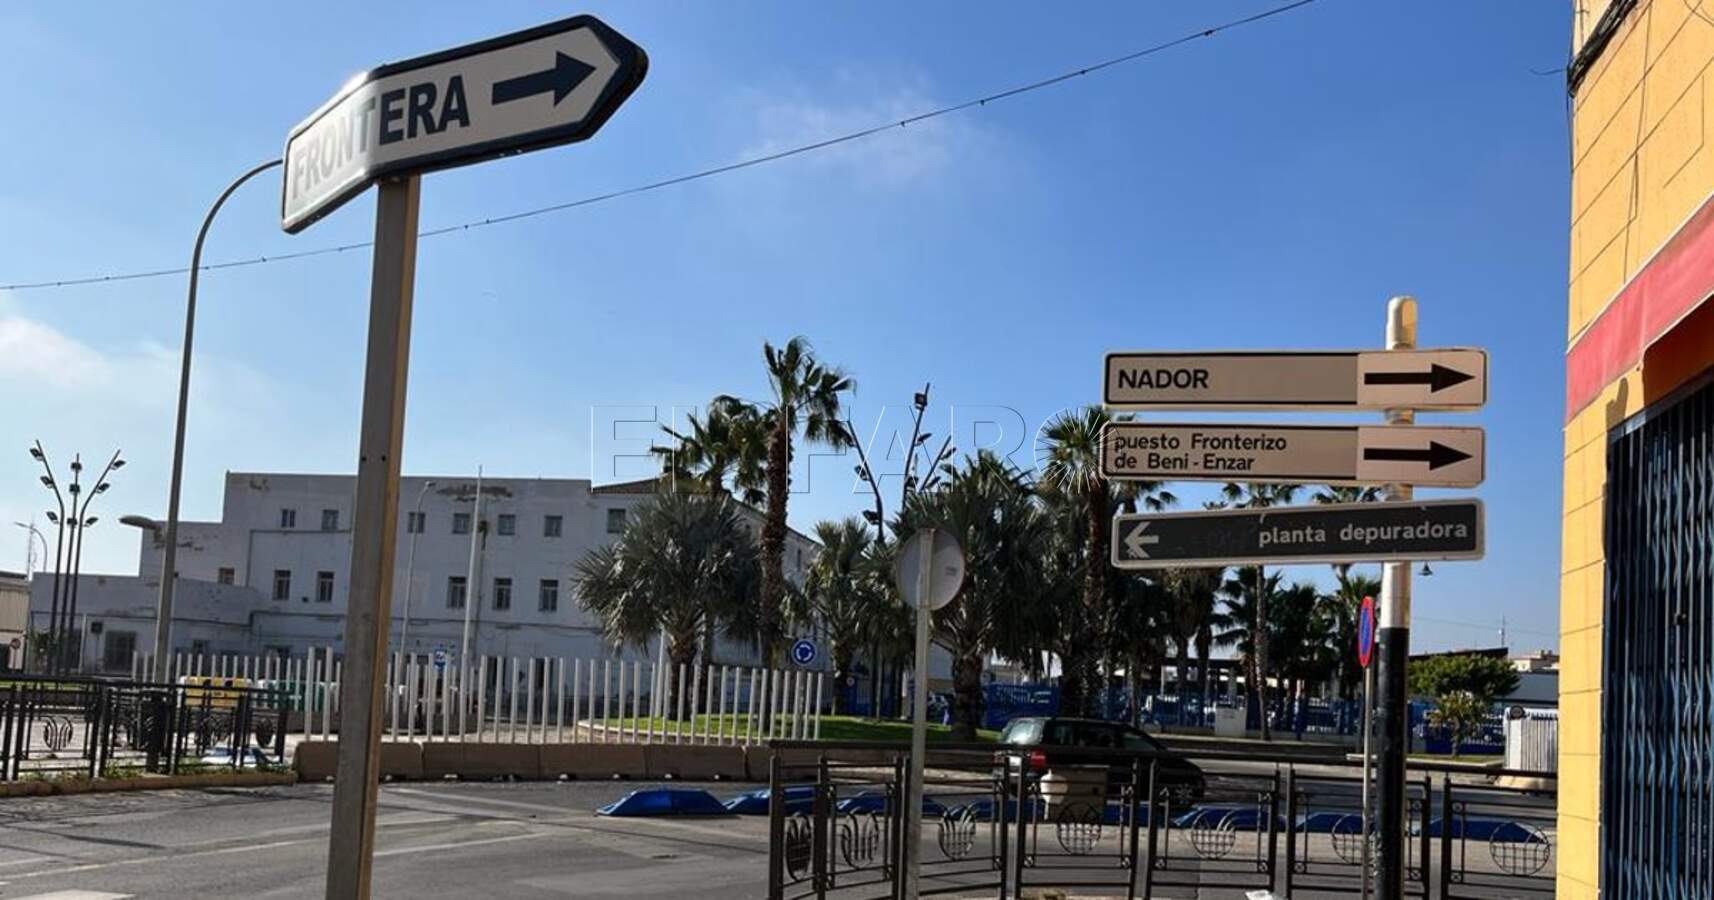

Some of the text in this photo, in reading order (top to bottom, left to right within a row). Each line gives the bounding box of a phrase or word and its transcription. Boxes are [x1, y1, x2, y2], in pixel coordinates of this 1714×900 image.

[292, 75, 470, 199] FRONTERA
[1118, 369, 1209, 389] NADOR
[1114, 433, 1287, 453] puesto Fronterizo
[1114, 453, 1138, 469] de
[1259, 521, 1468, 548] planta depuradora
